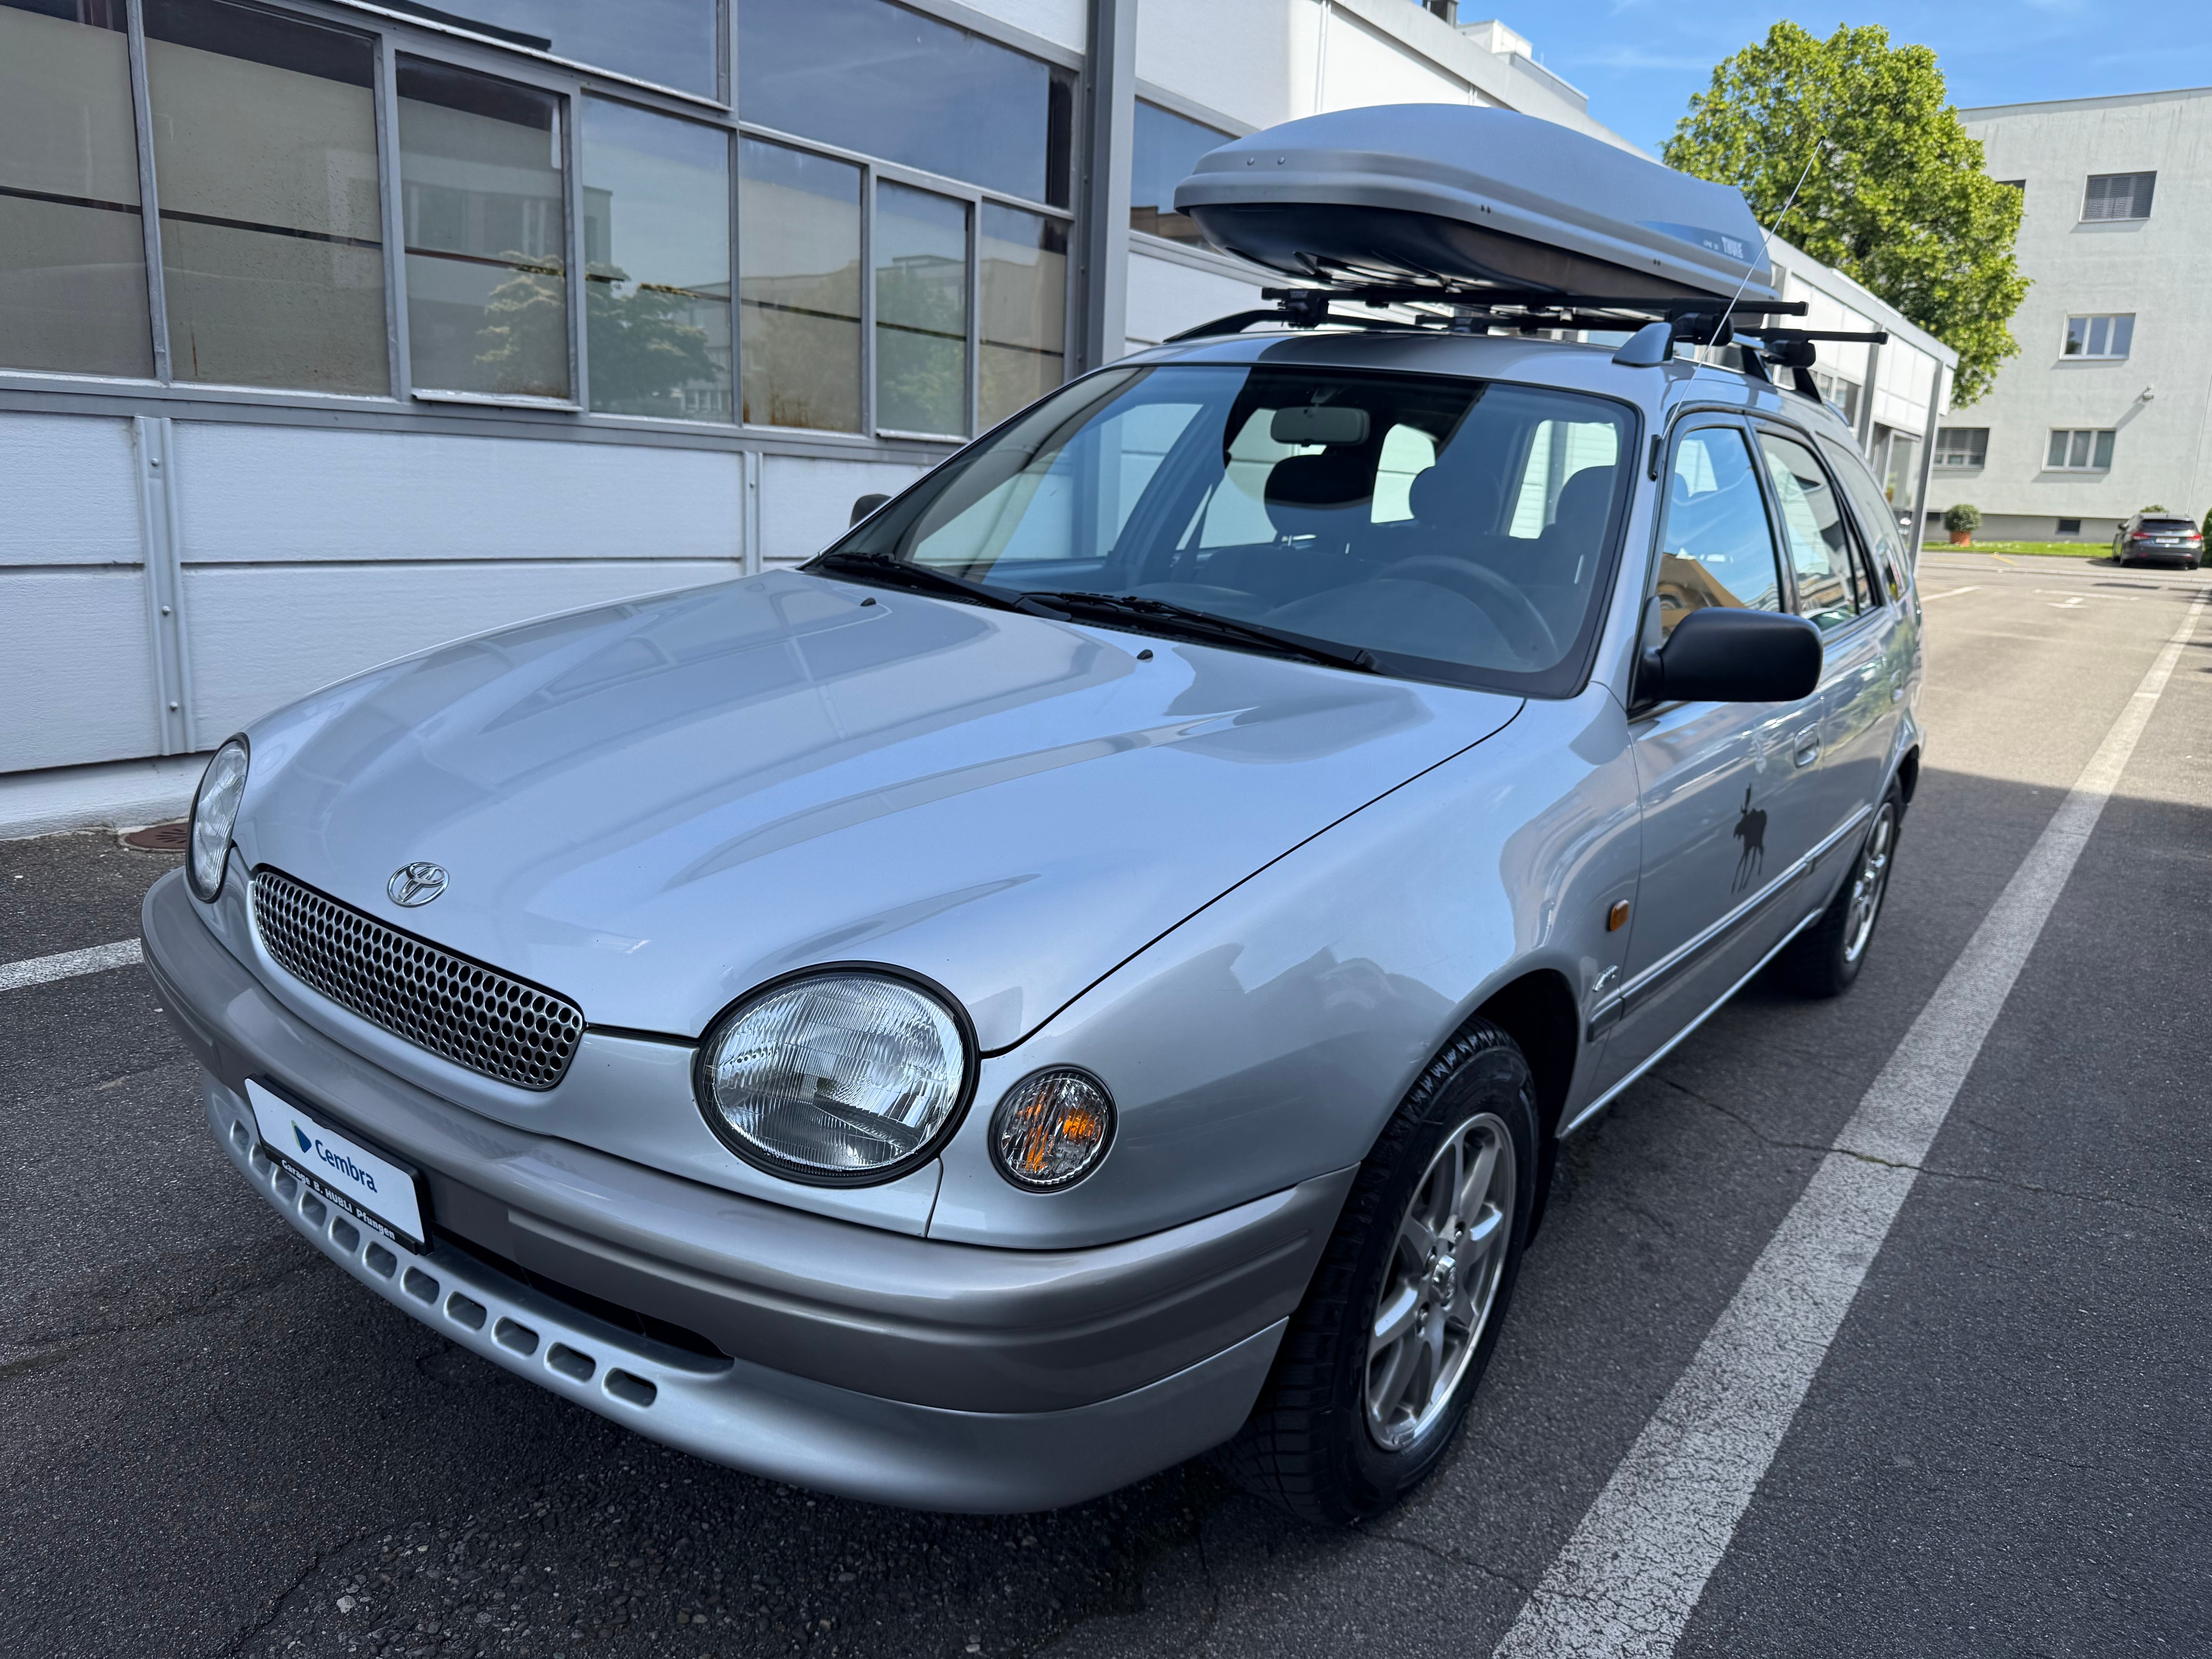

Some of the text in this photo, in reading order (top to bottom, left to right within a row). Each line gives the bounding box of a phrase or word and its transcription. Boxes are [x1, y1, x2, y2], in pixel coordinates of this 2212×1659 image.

[282, 1159, 395, 1240] Garage B. HUBLI Pfungen
[315, 1139, 377, 1193] Cembra
